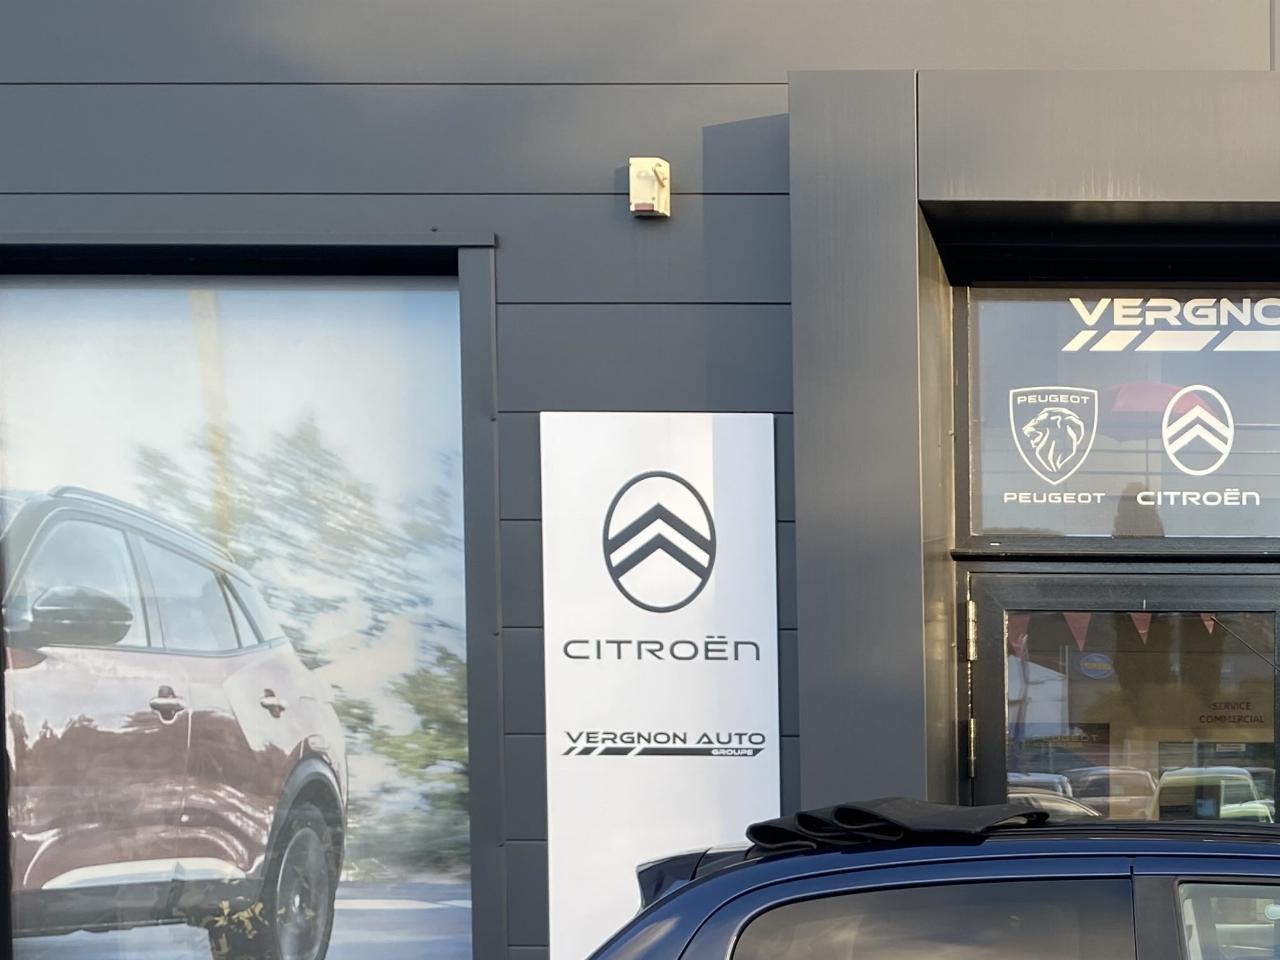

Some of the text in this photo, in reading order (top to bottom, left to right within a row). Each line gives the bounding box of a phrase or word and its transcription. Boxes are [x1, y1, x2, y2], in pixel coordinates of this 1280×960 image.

[1016, 394, 1091, 406] PEUGEOT
[1003, 492, 1106, 504] PEUGEOT
[1136, 487, 1260, 506] CITROËN
[563, 635, 761, 661] CITROËN
[1211, 702, 1253, 711] SERVICE
[1199, 714, 1265, 724] COMMERCIAL
[563, 731, 766, 745] VERGNON AUTO
[711, 748, 754, 756] GROUPE
